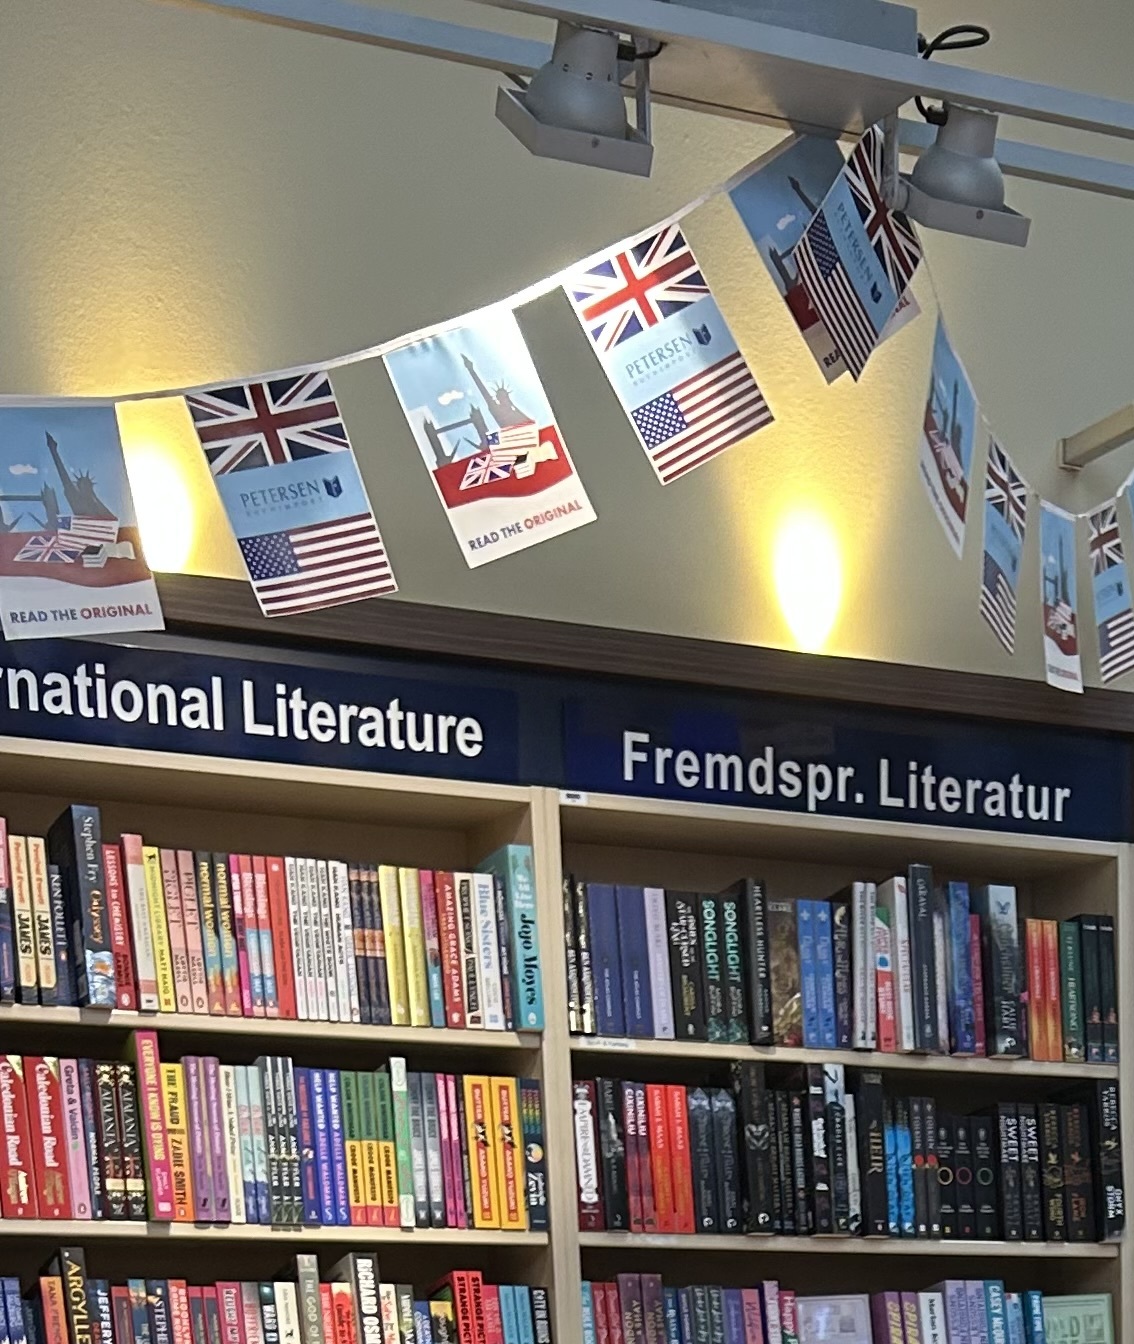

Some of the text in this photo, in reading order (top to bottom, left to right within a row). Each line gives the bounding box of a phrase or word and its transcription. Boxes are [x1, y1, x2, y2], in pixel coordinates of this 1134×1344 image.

[625, 333, 694, 379] PETERSEN
[239, 479, 320, 509] PETERSEN
[469, 500, 583, 552] READ THE ORIGINAL
[10, 604, 153, 623] READ THE ORIGINAL
[0, 664, 483, 757] national Literature
[622, 731, 1071, 822] Fremdspr. Literatur
[83, 816, 97, 884] Stephen Fry
[517, 914, 537, 1006] Jojo Moyes
[702, 900, 721, 981] SONGLIGHT
[724, 902, 741, 982] SONGLIGHT
[63, 1065, 78, 1140] Greta Valdin
[168, 1092, 180, 1125] FRAUD
[171, 1138, 186, 1205] ZADIE SMITH
[357, 1258, 375, 1314] RICHARD
[457, 1276, 471, 1327] STRANGE
[472, 1276, 485, 1327] STRANGE
[783, 1296, 794, 1335] Happy
